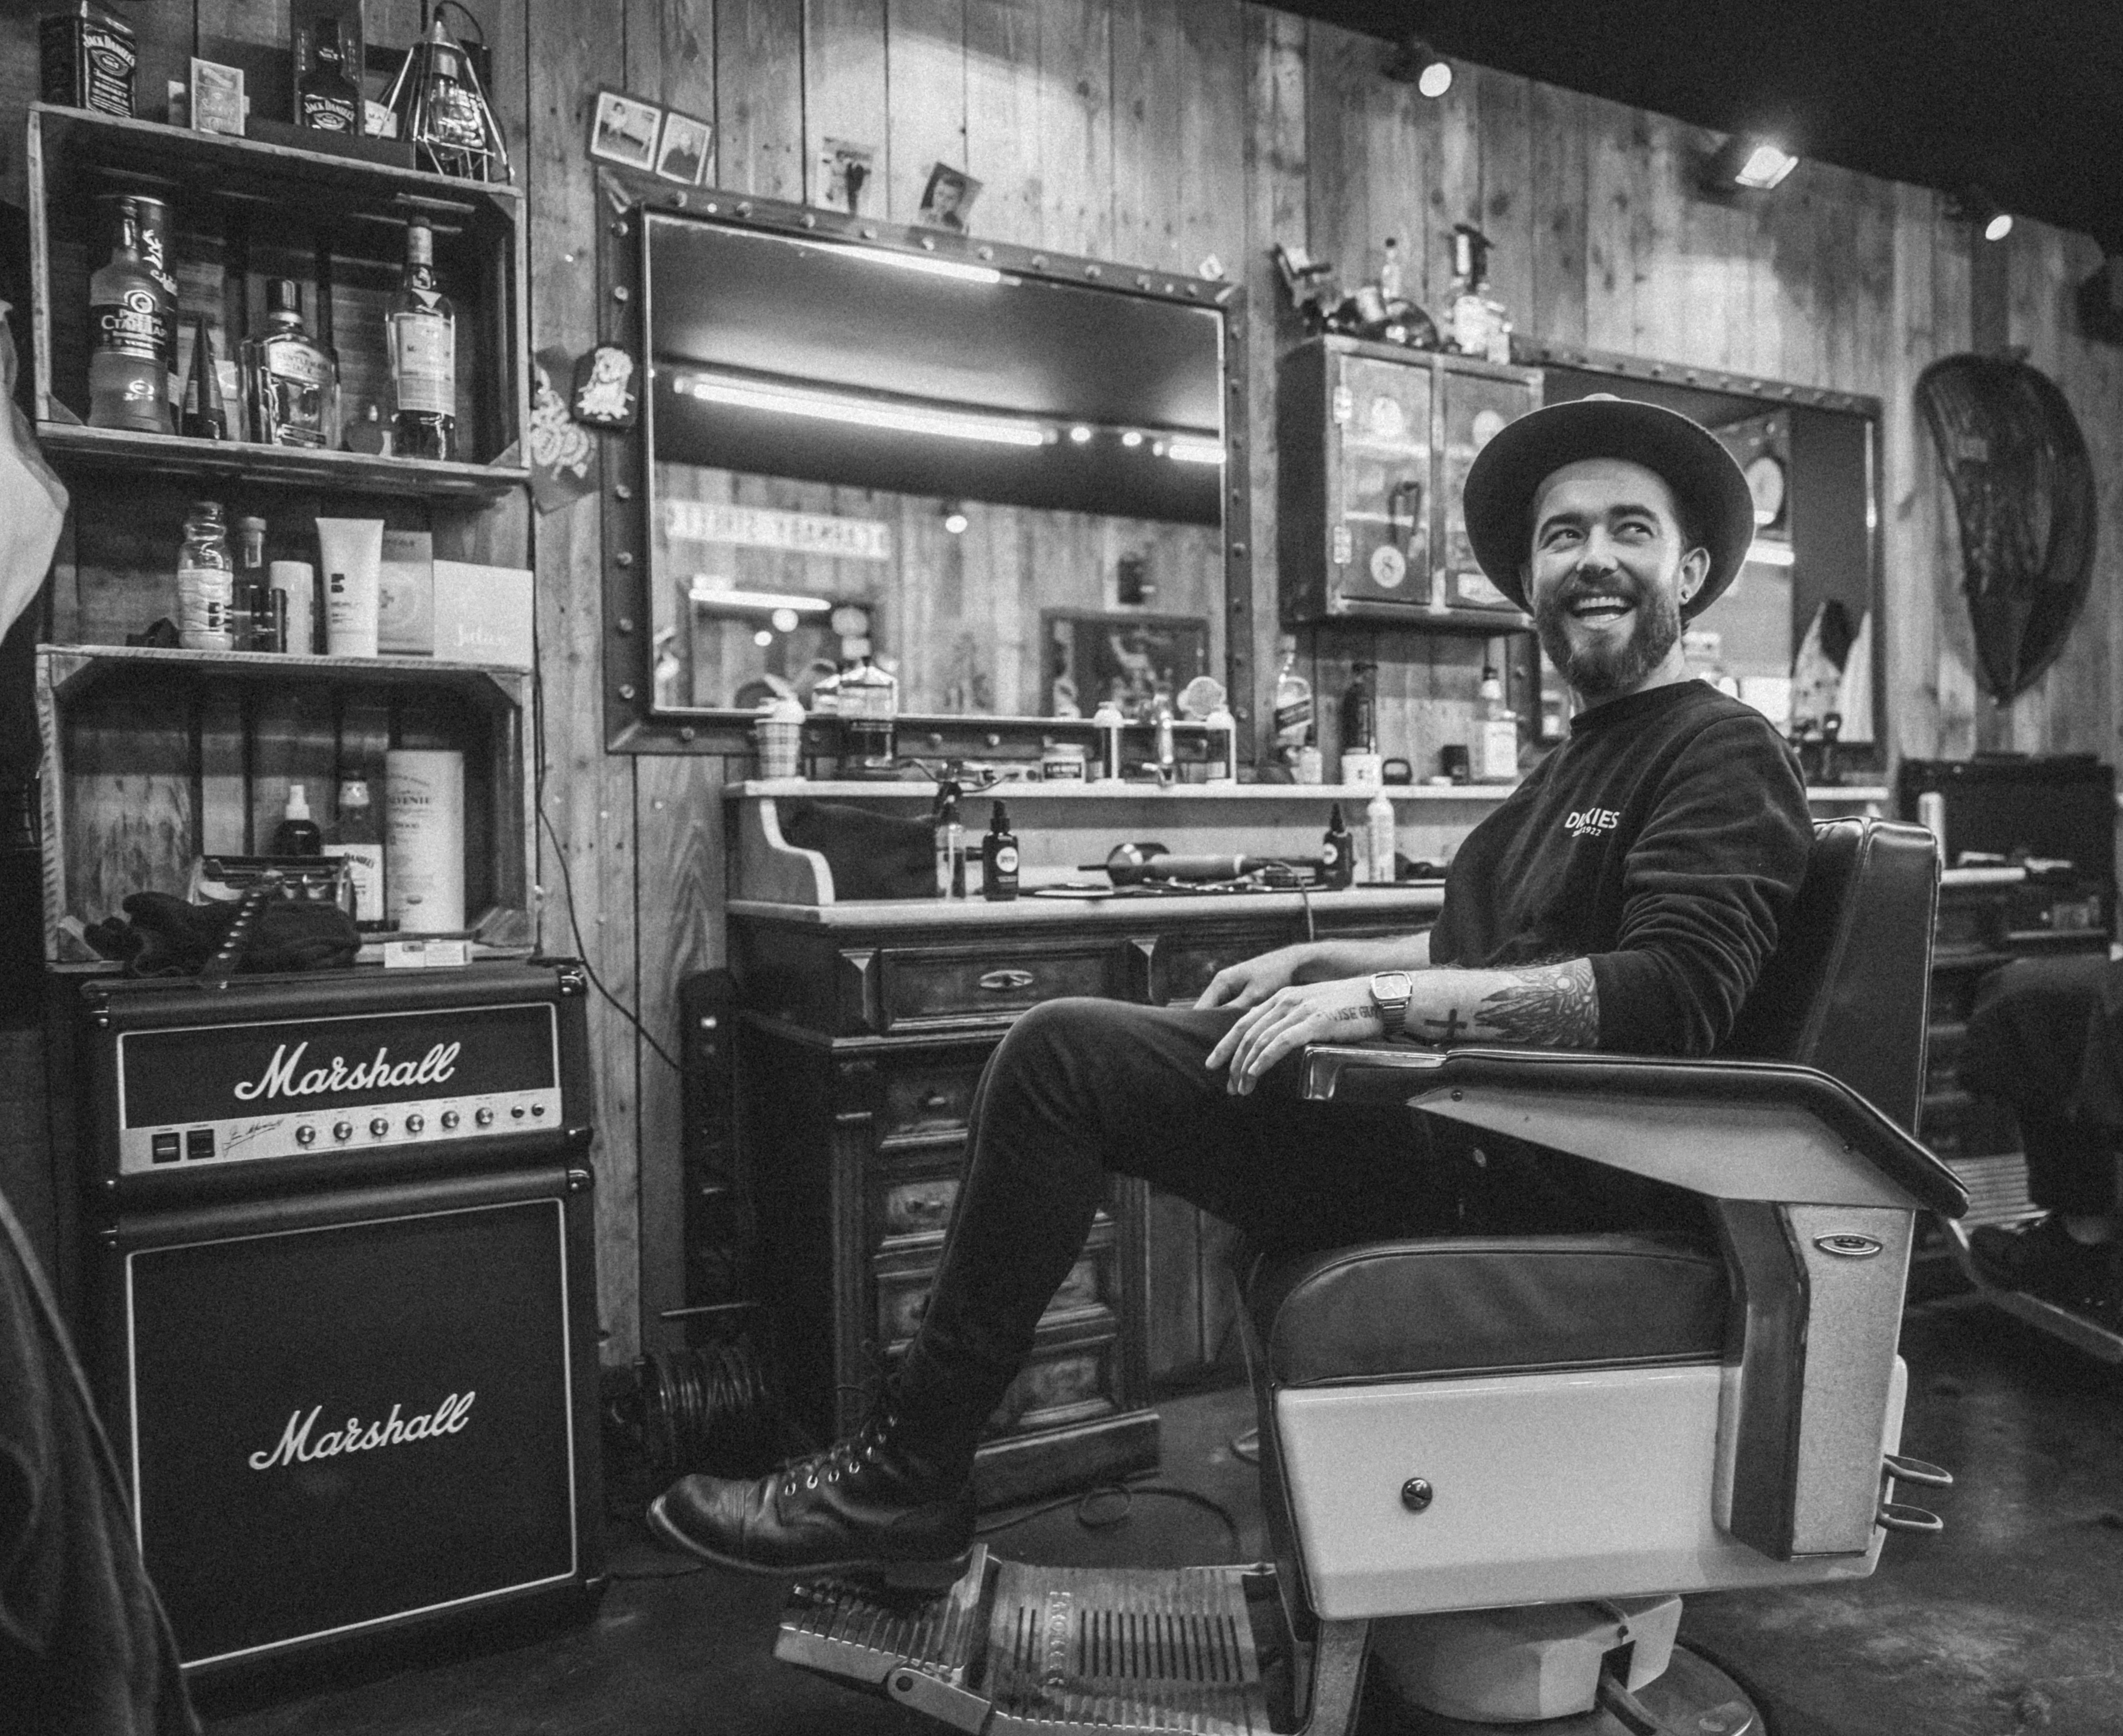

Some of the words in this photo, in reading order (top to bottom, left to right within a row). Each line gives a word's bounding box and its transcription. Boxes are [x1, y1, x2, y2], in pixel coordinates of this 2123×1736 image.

[304, 102, 325, 114] JACK
[1581, 826, 1601, 836] 1922
[234, 1042, 460, 1100] Marshall
[249, 1391, 475, 1469] Marshall
